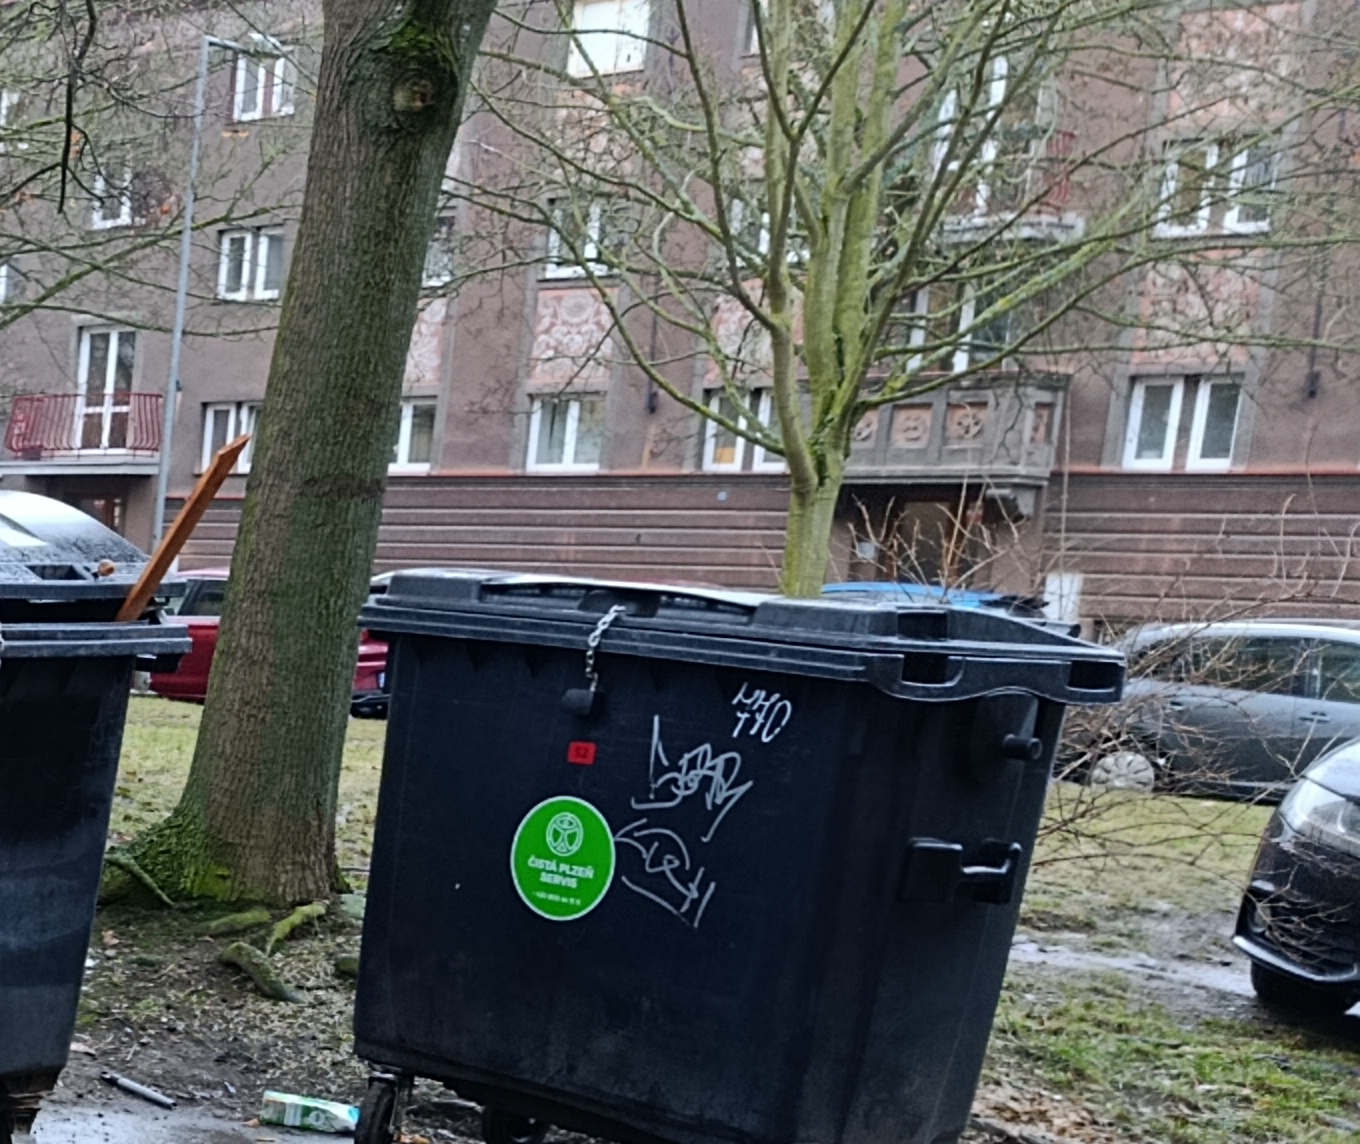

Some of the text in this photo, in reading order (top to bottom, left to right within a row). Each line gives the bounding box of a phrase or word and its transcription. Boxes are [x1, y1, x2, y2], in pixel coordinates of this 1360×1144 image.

[527, 854, 595, 879] ČISTÁ PLZEŇ
[540, 871, 578, 888] SERVIS
